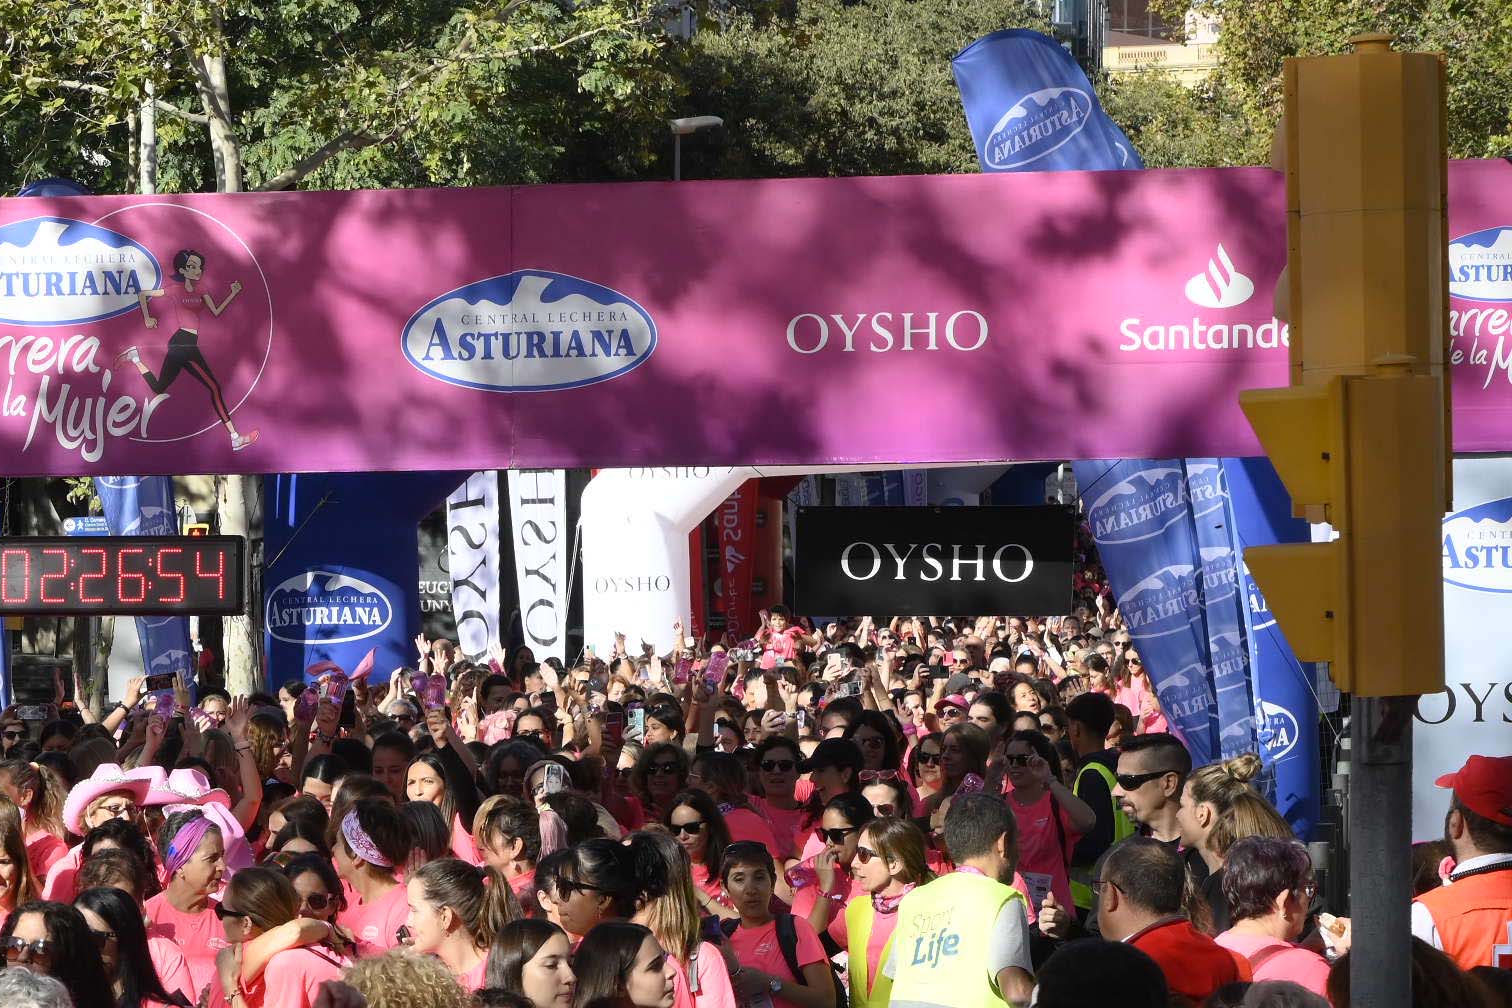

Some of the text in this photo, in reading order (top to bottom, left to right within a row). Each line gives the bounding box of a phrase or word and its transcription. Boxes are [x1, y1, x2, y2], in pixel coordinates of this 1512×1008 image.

[63, 253, 137, 265] LECHERA
[461, 311, 627, 324] CENTRAL LECHERA
[787, 311, 989, 354] OYSHO
[1119, 317, 1291, 351] Santande
[423, 317, 636, 362] ASTURIANA
[2, 379, 26, 417] la
[22, 368, 170, 462] Mujer
[1, 548, 223, 603] 02:26:54
[841, 541, 1035, 583] OYSHO
[326, 596, 378, 605] LECHERA
[594, 574, 671, 594] OYSHO
[270, 598, 383, 629] ASTURIANA
[911, 927, 960, 969] Life
